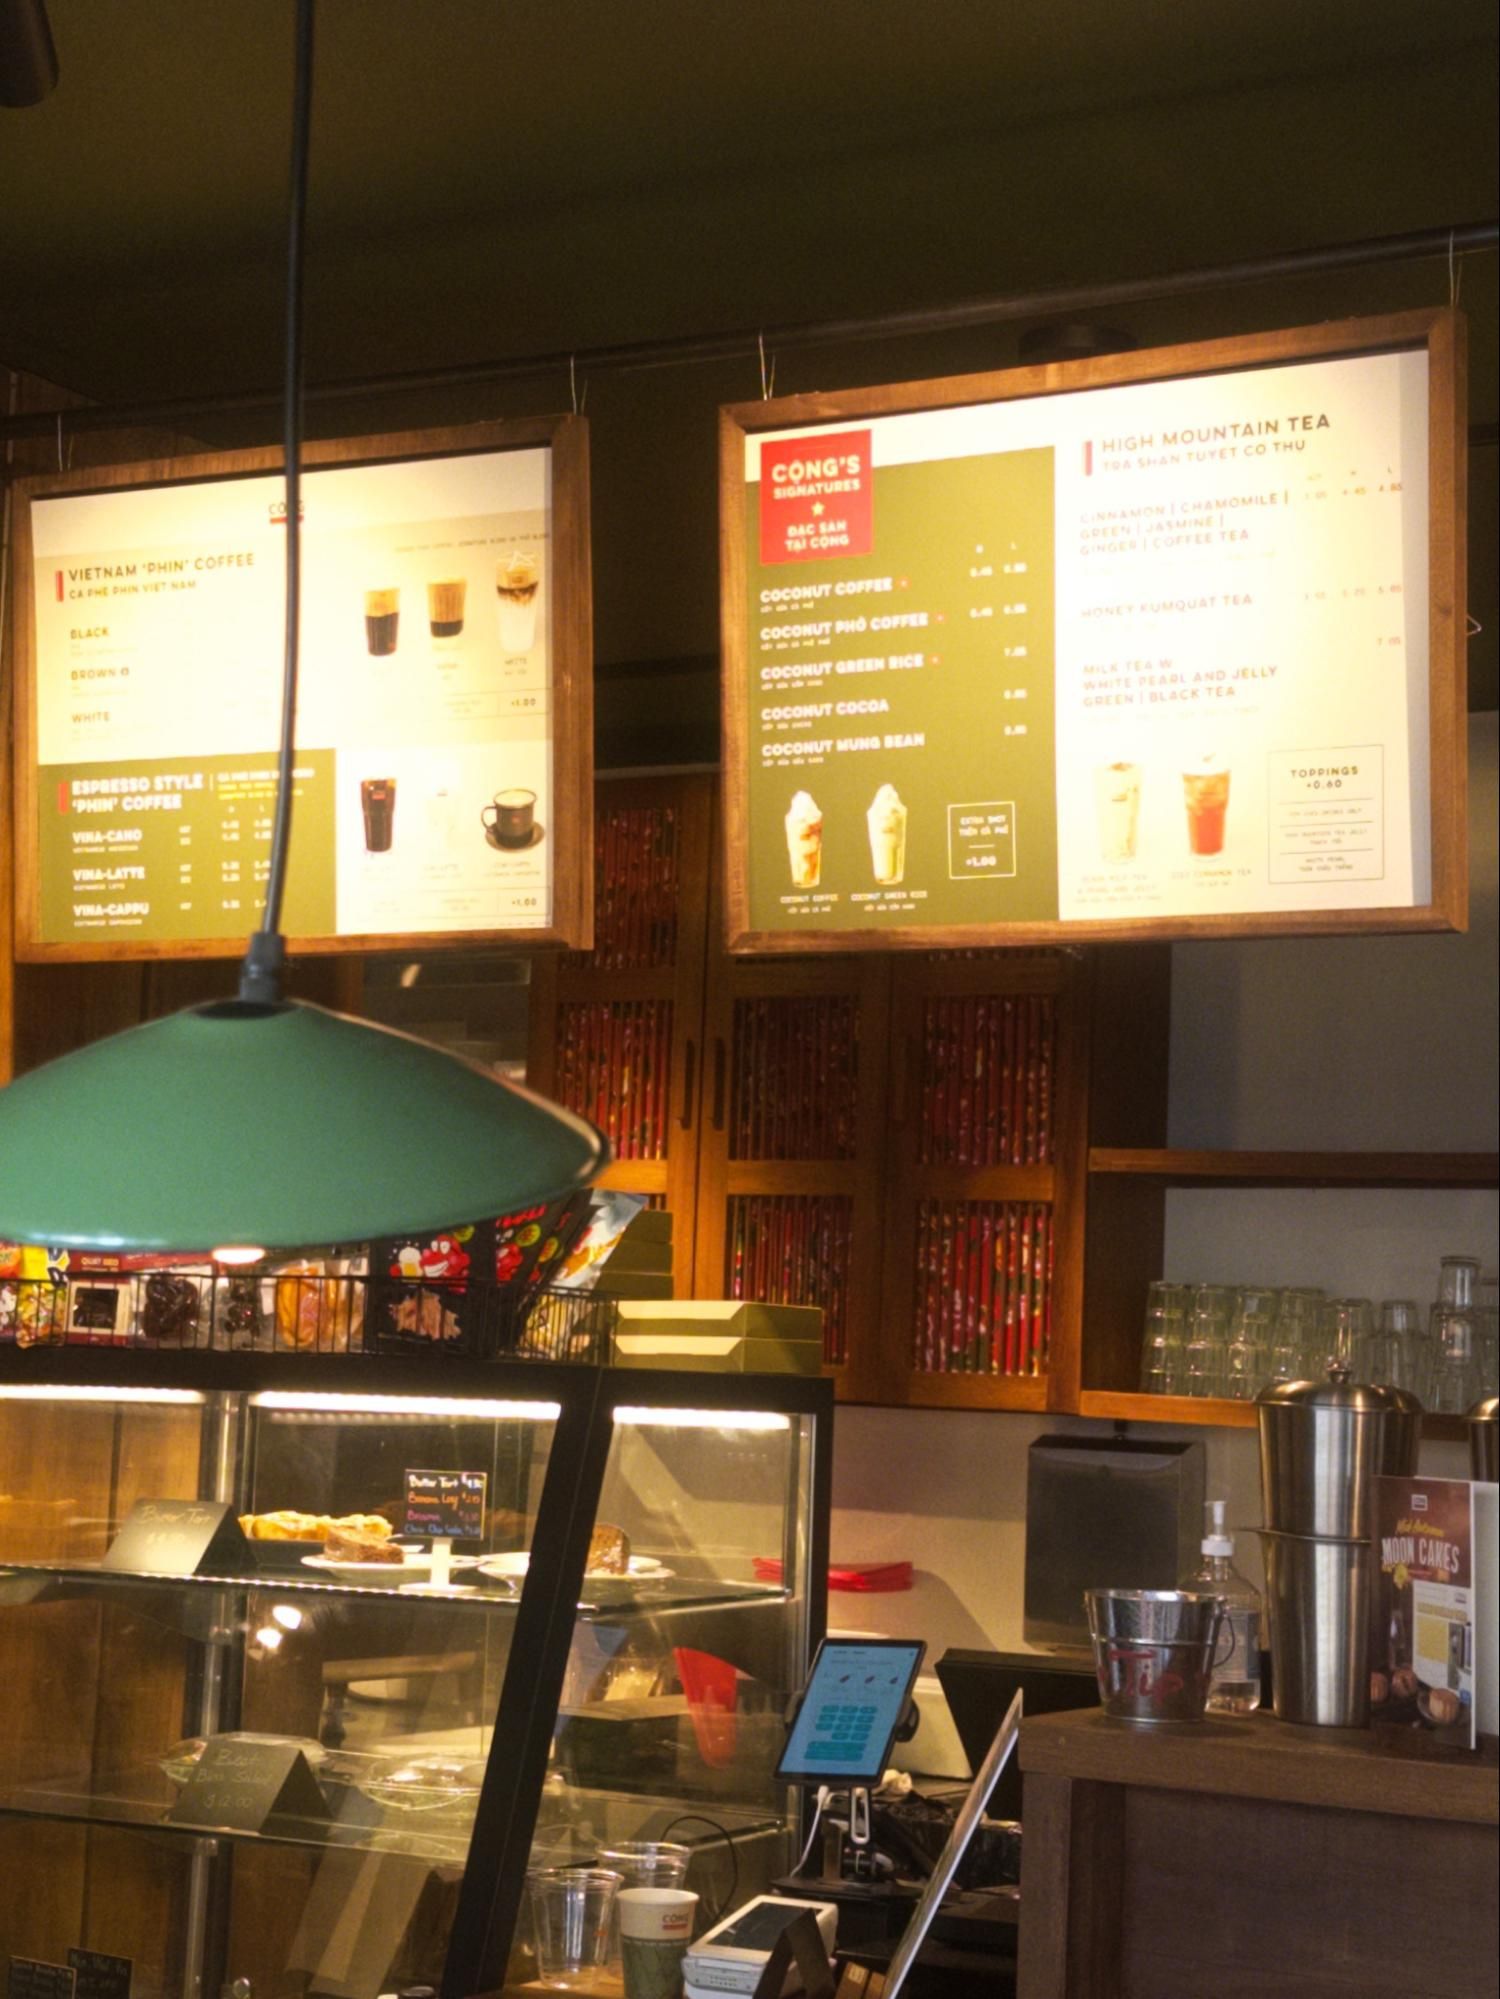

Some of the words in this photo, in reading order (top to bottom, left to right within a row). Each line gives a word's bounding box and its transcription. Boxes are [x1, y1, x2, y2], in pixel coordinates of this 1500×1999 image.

[1102, 434, 1153, 453] HIGH
[1162, 419, 1279, 448] MOUNTAIN
[1288, 413, 1331, 433] TEA
[773, 479, 860, 500] SIGNATURES
[1080, 506, 1165, 523] CINNAMON
[1180, 493, 1278, 513] CHAMOMILE
[1080, 525, 1131, 541] GREEN
[1146, 516, 1214, 534] JASMINE
[1080, 539, 1137, 556] GINGER
[1153, 532, 1213, 550] COFFEE
[1219, 528, 1249, 543] TEA
[68, 564, 137, 582] VIETNAM
[194, 553, 255, 571] COFFEE
[113, 585, 139, 596] PHIN
[171, 580, 197, 591] NAM
[760, 583, 832, 603] COCONUT
[835, 576, 893, 596] COFFEE
[1081, 605, 1134, 619] HONEY
[1140, 596, 1216, 614] KUMQUAT
[1222, 593, 1253, 607] TEA
[70, 627, 110, 641] BLACK
[760, 622, 832, 640] COCONUT
[870, 612, 928, 631] COFFEE
[71, 667, 117, 681] BROWN
[761, 662, 832, 681] COCONUT
[836, 658, 885, 674] GREEN
[888, 653, 924, 670] RICE
[1083, 663, 1118, 675] MILK
[1126, 660, 1153, 672] TEA
[1083, 677, 1131, 690] WHITE
[1139, 673, 1186, 687] PEARL
[1192, 669, 1227, 683] AND
[1232, 665, 1278, 681] JELLY
[1083, 693, 1135, 708] GREEN
[1149, 688, 1200, 703] BLACK
[1206, 685, 1236, 698] TEA
[72, 711, 110, 723] WHITE
[761, 703, 833, 721] COCONUT
[836, 698, 889, 715] COCOA
[762, 740, 834, 757] COCONUT
[837, 736, 880, 752] MUNG
[884, 732, 925, 749] BEAN
[1290, 765, 1358, 779] TOPPINGS
[72, 777, 150, 796] ESPRESSO
[154, 772, 204, 791] STYLE
[122, 793, 182, 811] COFFEE
[72, 829, 143, 844] VINA-CANO
[73, 866, 146, 881] VINA-LATTE
[73, 902, 150, 917] VINA-CAPPU
[1382, 1537, 1415, 1567] MOON
[1419, 1538, 1460, 1574] CAKES
